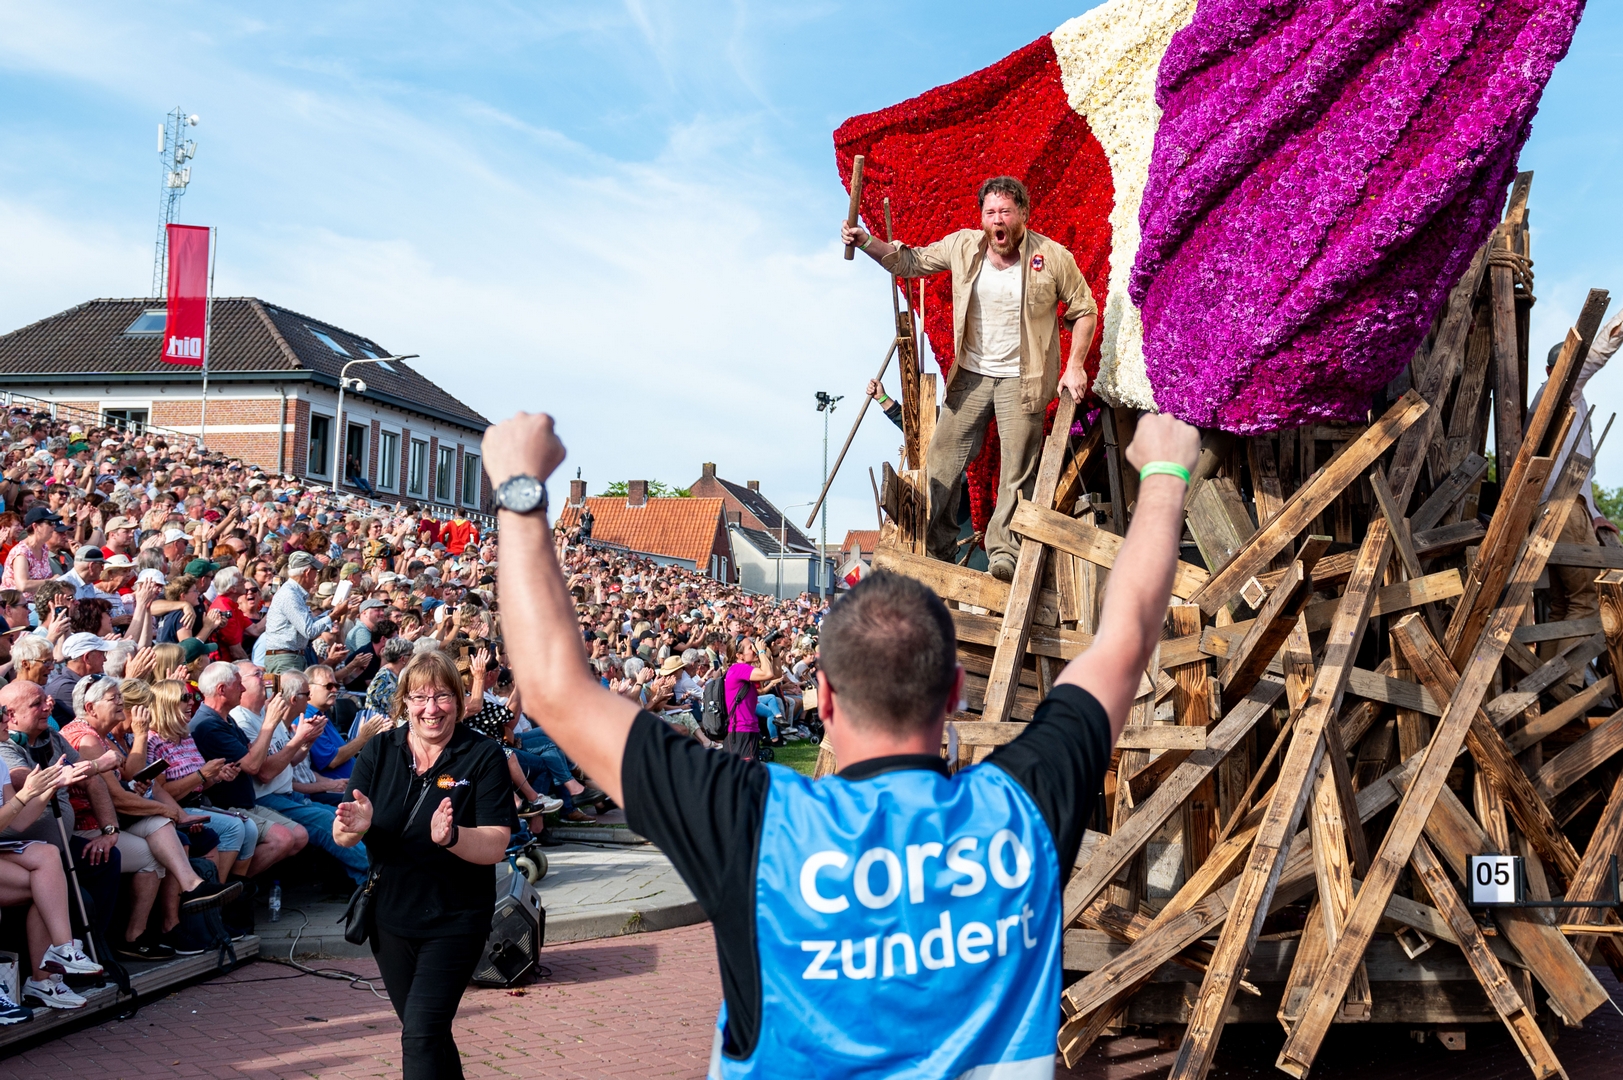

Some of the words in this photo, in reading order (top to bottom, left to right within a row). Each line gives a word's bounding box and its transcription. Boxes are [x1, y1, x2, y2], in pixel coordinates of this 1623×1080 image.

[800, 829, 1031, 914] corso
[1476, 862, 1510, 886] 05
[801, 904, 1038, 980] zundert
